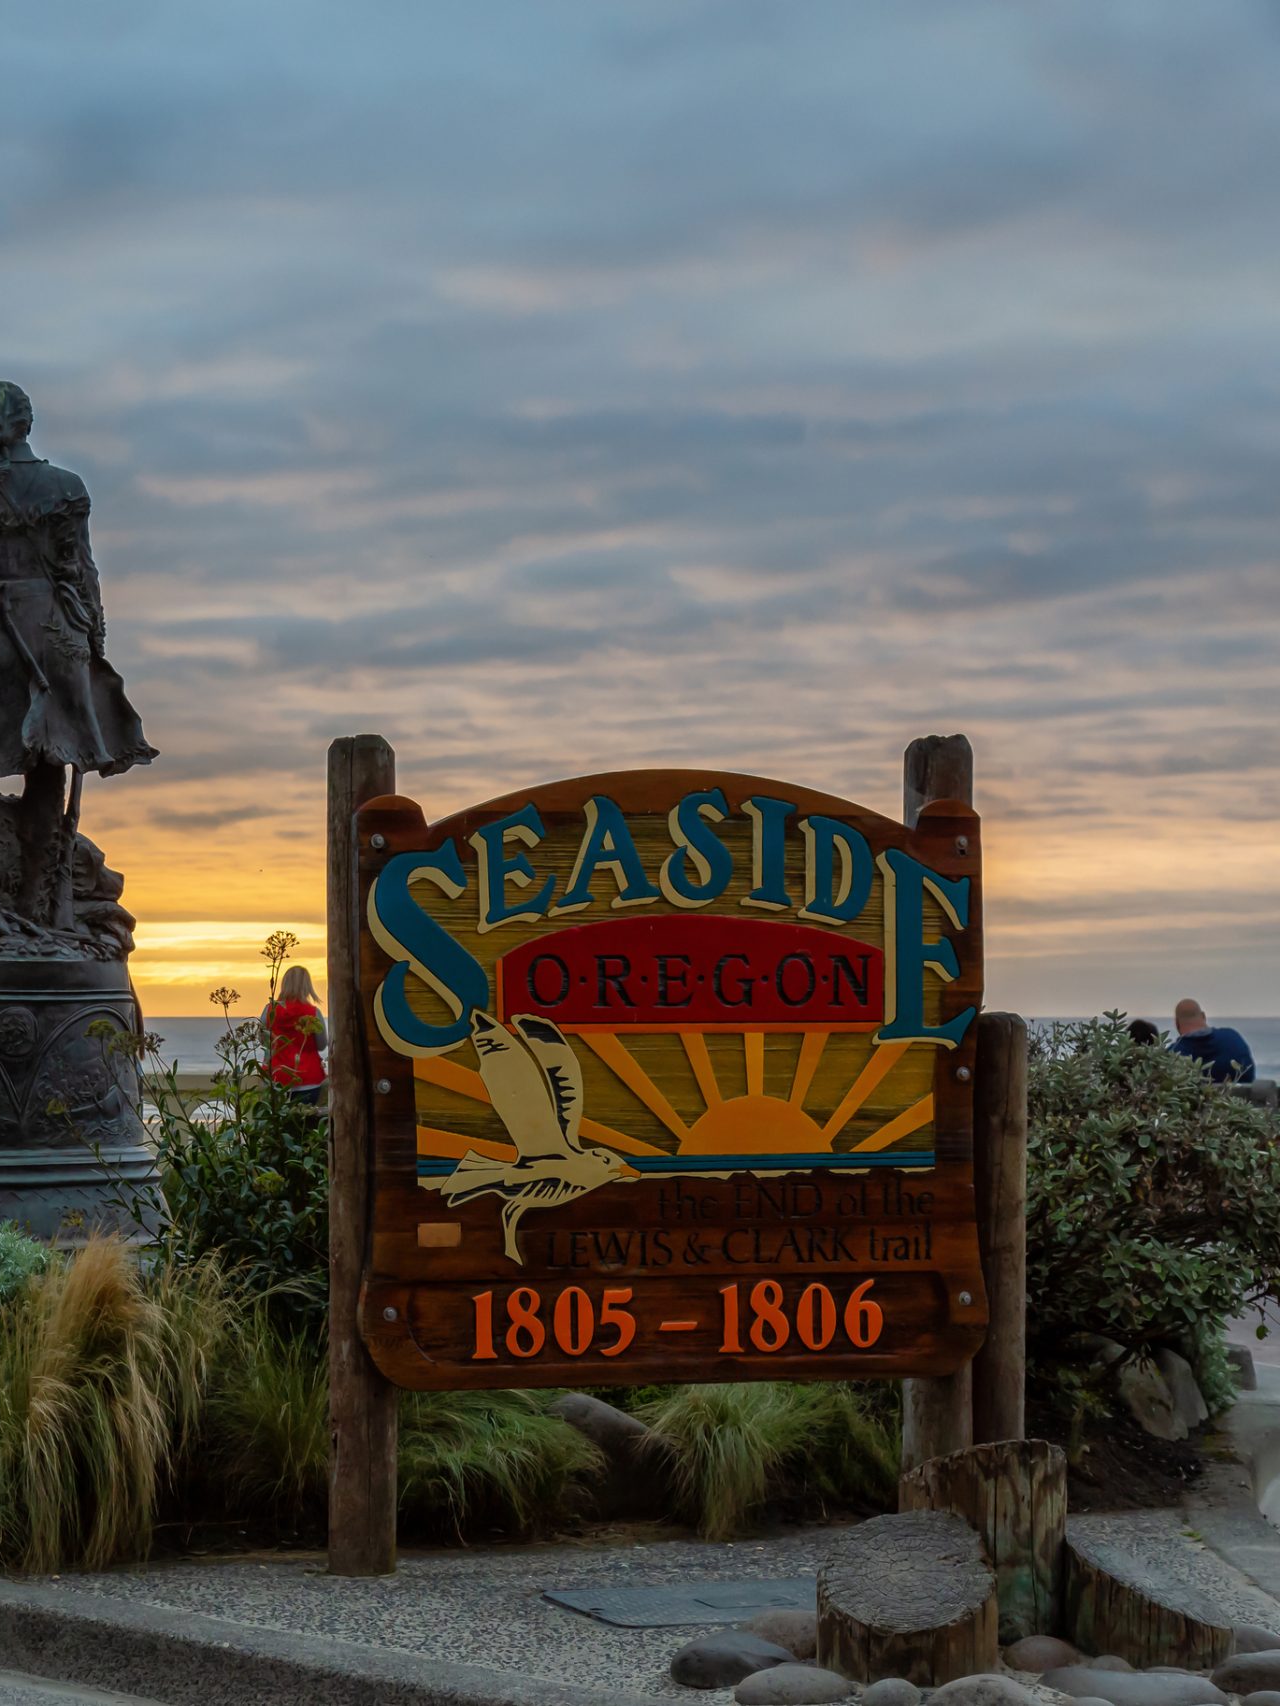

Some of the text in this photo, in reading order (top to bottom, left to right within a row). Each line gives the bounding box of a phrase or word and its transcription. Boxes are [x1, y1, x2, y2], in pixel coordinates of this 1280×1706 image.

[367, 787, 977, 1058] SEASIDE
[657, 1178, 935, 1220] the END of the
[546, 1222, 933, 1270] LEWIS & CLARK trail
[471, 1286, 637, 1360] 1805
[718, 1278, 884, 1354] 1806
